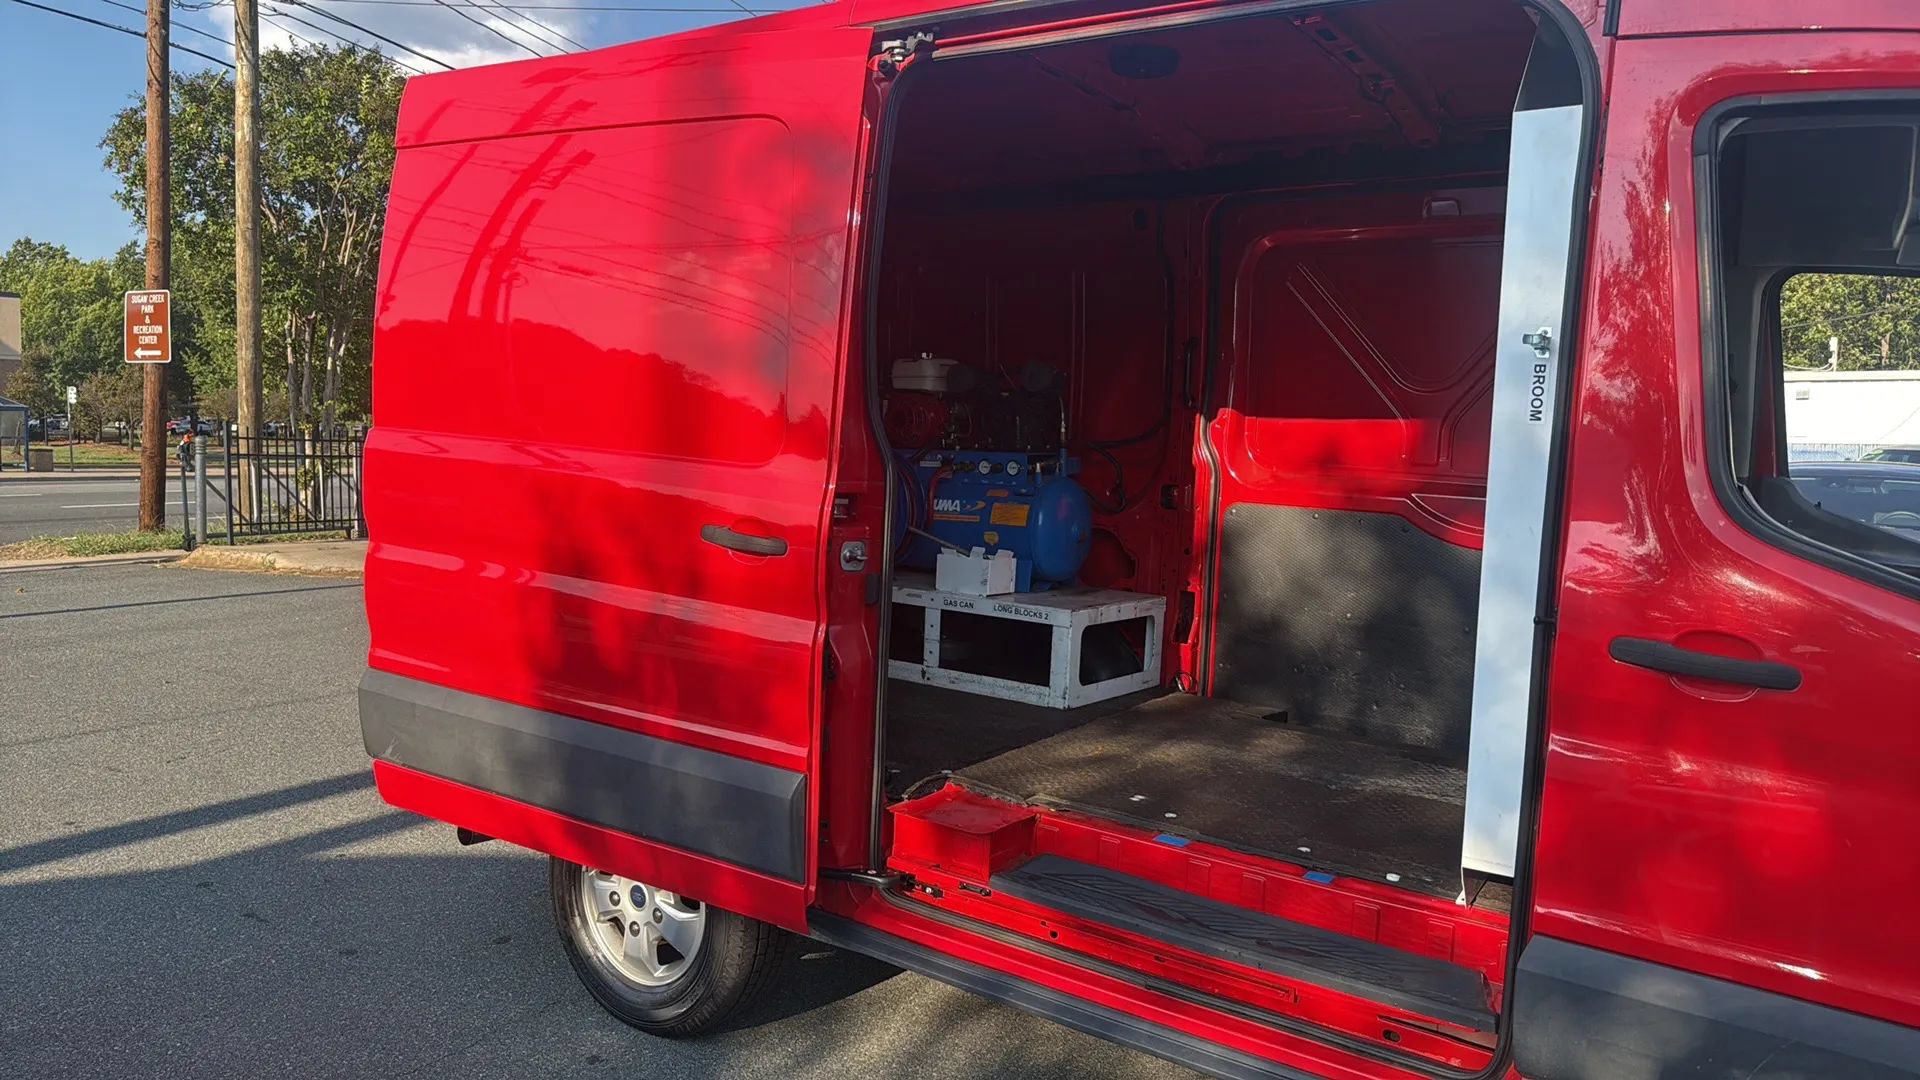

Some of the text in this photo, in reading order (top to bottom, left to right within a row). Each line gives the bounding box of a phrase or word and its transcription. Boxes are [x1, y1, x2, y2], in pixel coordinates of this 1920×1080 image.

[149, 294, 165, 303] CREEK
[141, 304, 154, 314] PARK
[144, 315, 151, 324] &
[132, 325, 163, 335] RECREATION
[138, 335, 158, 345] CENTER
[1529, 364, 1547, 422] BROOM
[933, 499, 960, 512] UMA
[943, 598, 974, 609] GAS CAN
[993, 604, 1049, 620] LONG BLOCKS 2
